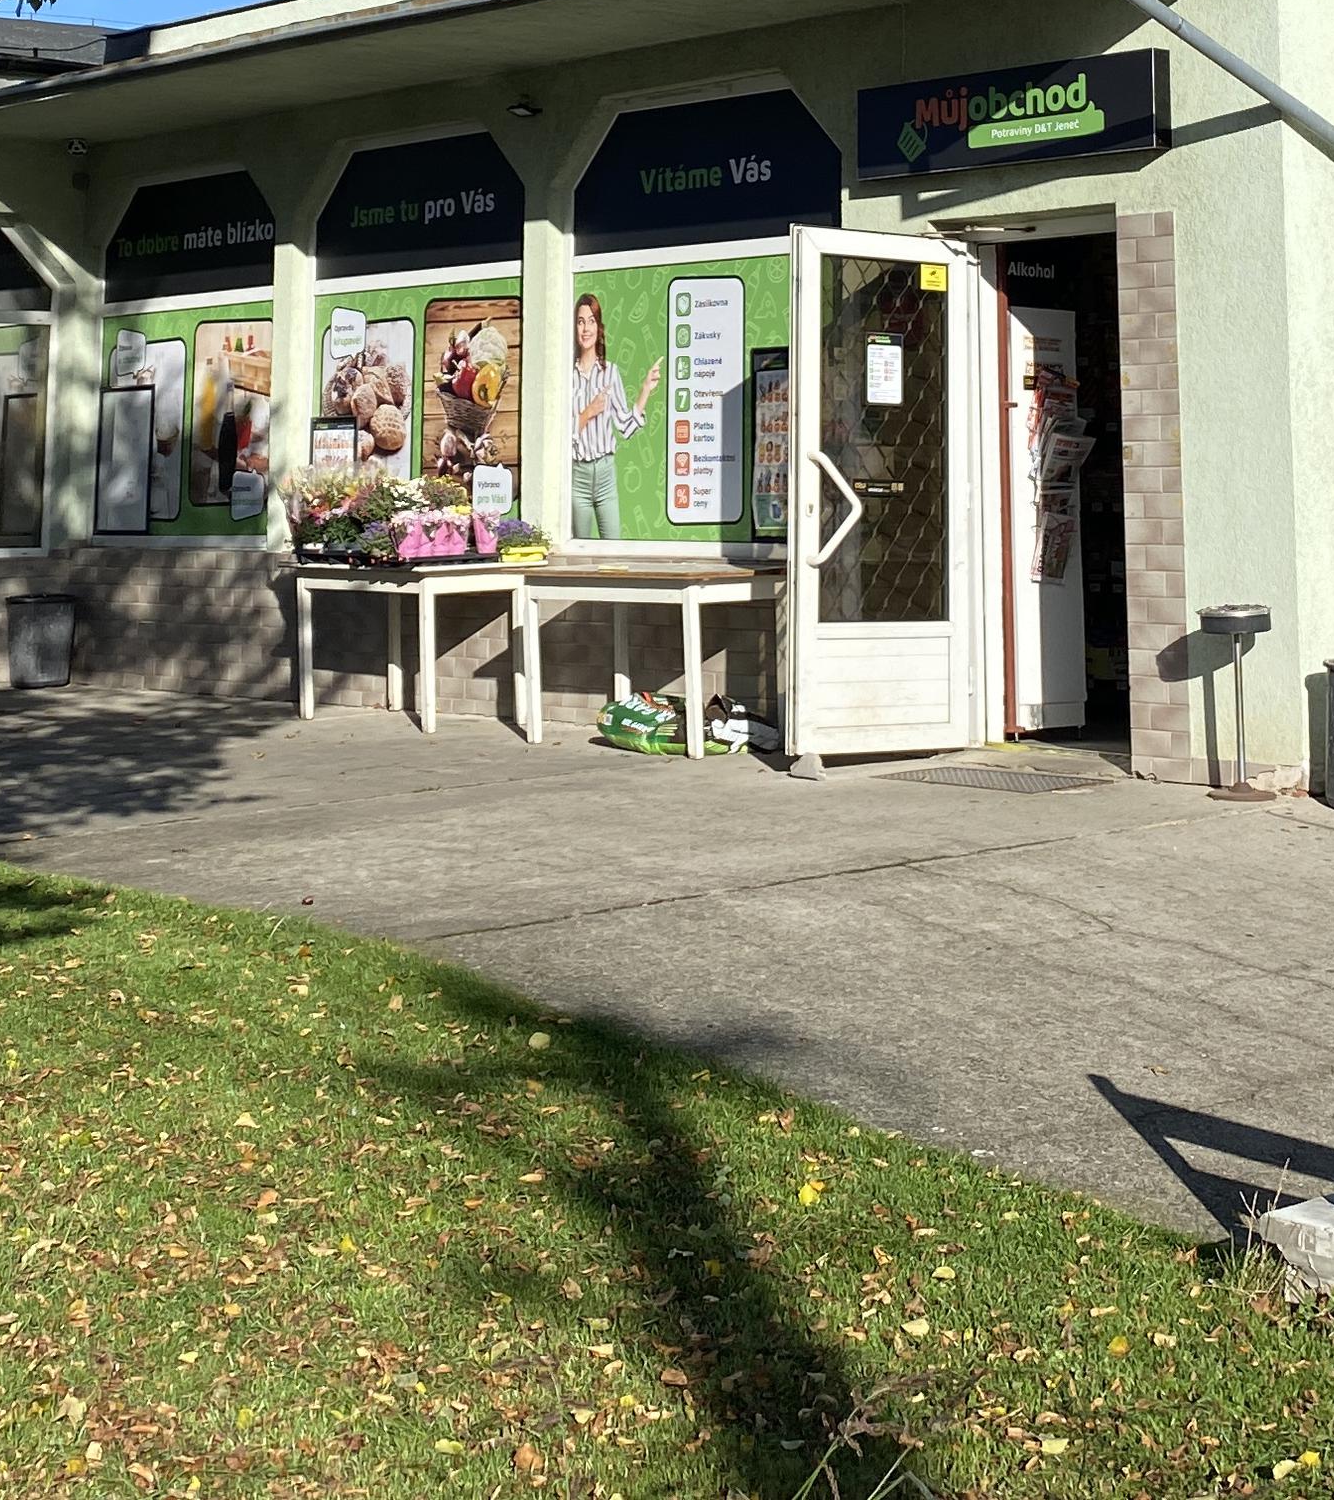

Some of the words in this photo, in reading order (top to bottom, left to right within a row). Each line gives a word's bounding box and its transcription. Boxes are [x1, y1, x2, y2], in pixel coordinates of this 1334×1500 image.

[991, 125, 1033, 139] Potraviny
[1034, 121, 1053, 134] D&T
[639, 164, 722, 195] Vítáme
[729, 154, 772, 185] Vás
[350, 205, 395, 229] Jsme
[399, 199, 419, 223] tu
[424, 198, 455, 225] pro
[460, 188, 495, 215] Vás
[116, 237, 133, 258] To
[183, 225, 223, 251] máte
[226, 218, 274, 245] blízko
[1007, 261, 1055, 279] Alkohol
[678, 390, 688, 409] 7
[693, 421, 715, 430] Platba
[693, 433, 715, 443] kartou
[693, 486, 711, 496] Super
